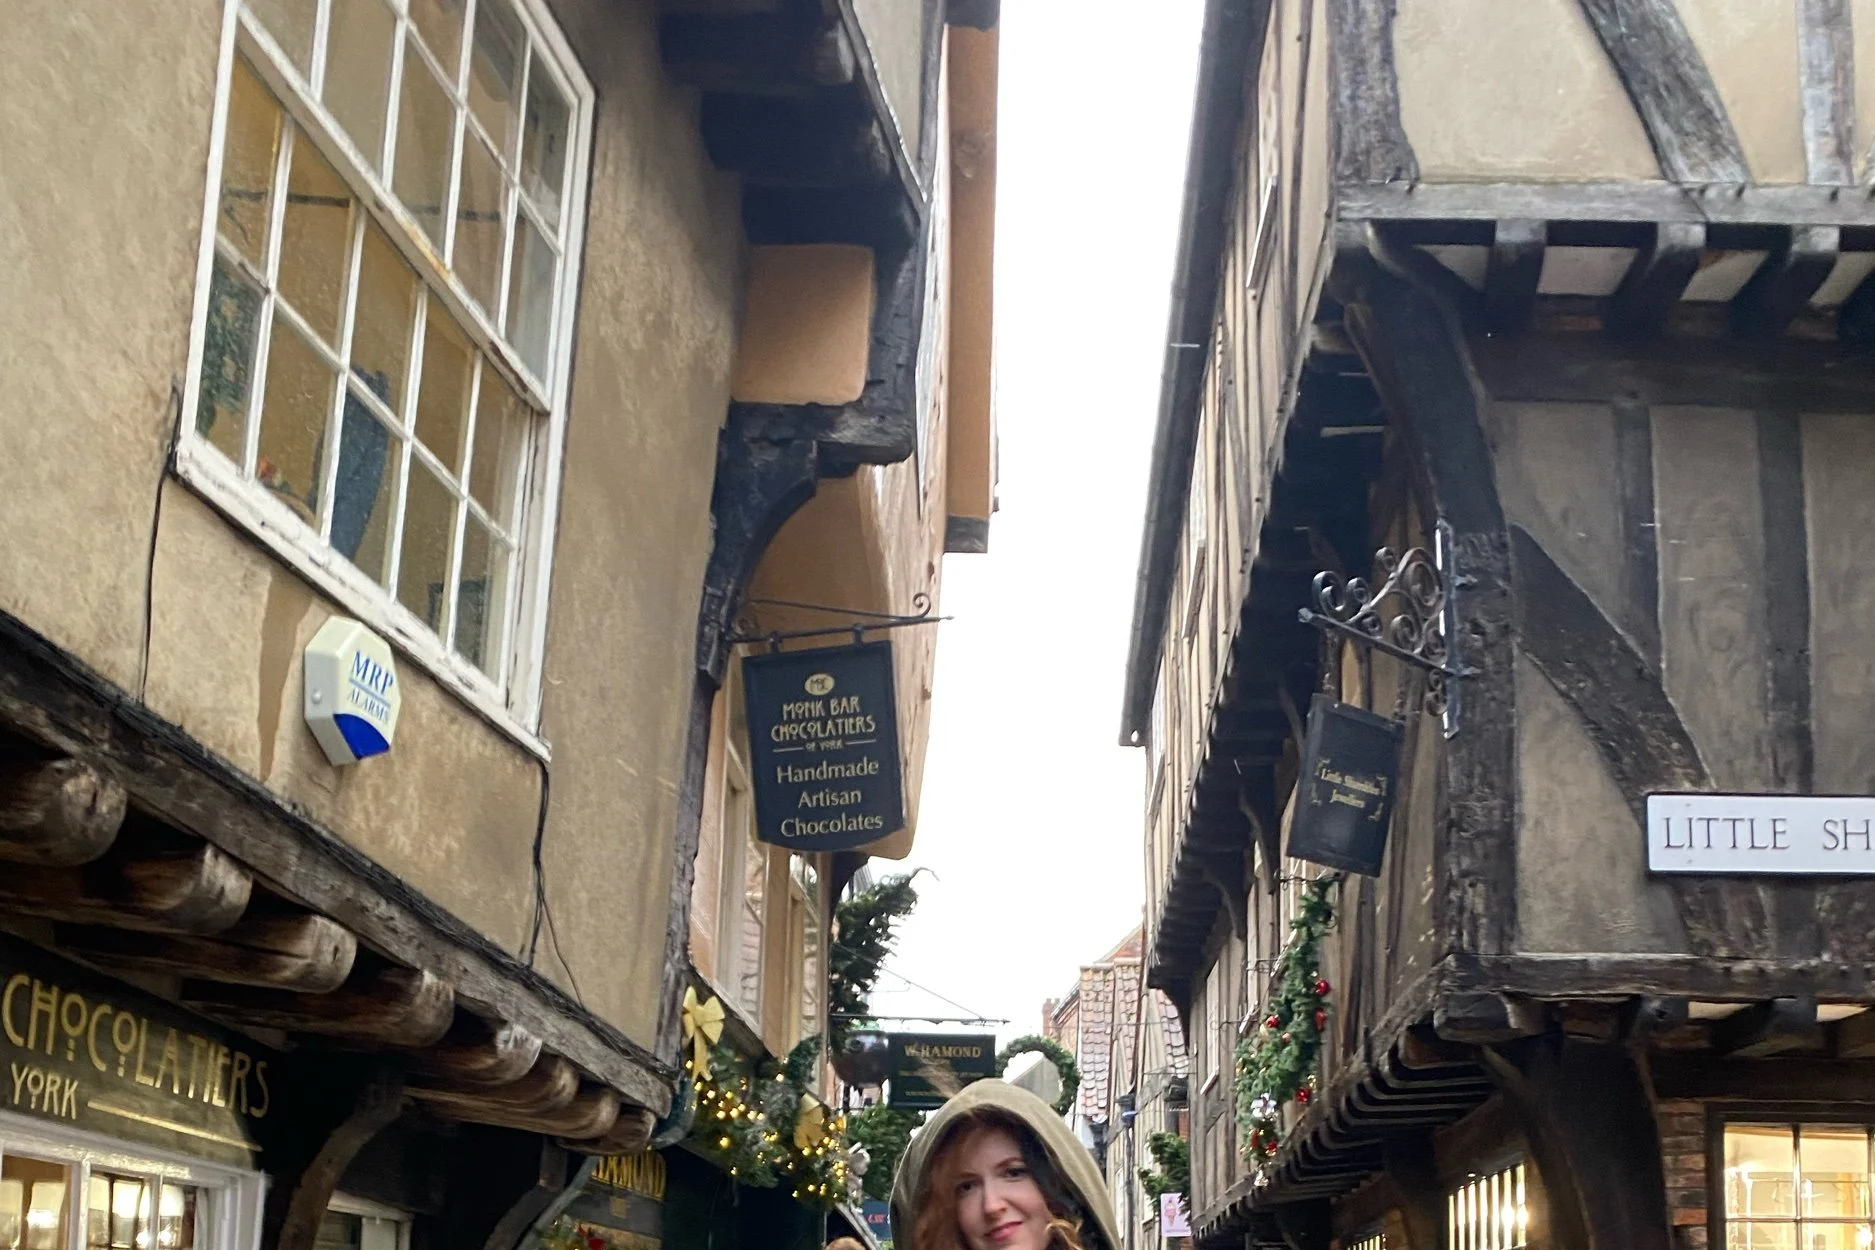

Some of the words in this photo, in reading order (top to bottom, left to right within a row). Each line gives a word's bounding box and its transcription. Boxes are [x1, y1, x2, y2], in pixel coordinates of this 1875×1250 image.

[351, 650, 394, 694] MRP
[349, 687, 390, 724] ALARMS
[782, 700, 825, 721] MONK
[830, 696, 860, 716] BAR
[771, 715, 876, 742] CHOCOLATIERS
[776, 756, 880, 784] Handmade
[798, 788, 862, 809] Artisan
[780, 812, 884, 837] Chocolates
[1664, 816, 1791, 850] LITTLE
[2, 973, 268, 1118] CHOCOLATIERS
[11, 1062, 78, 1119] YORK
